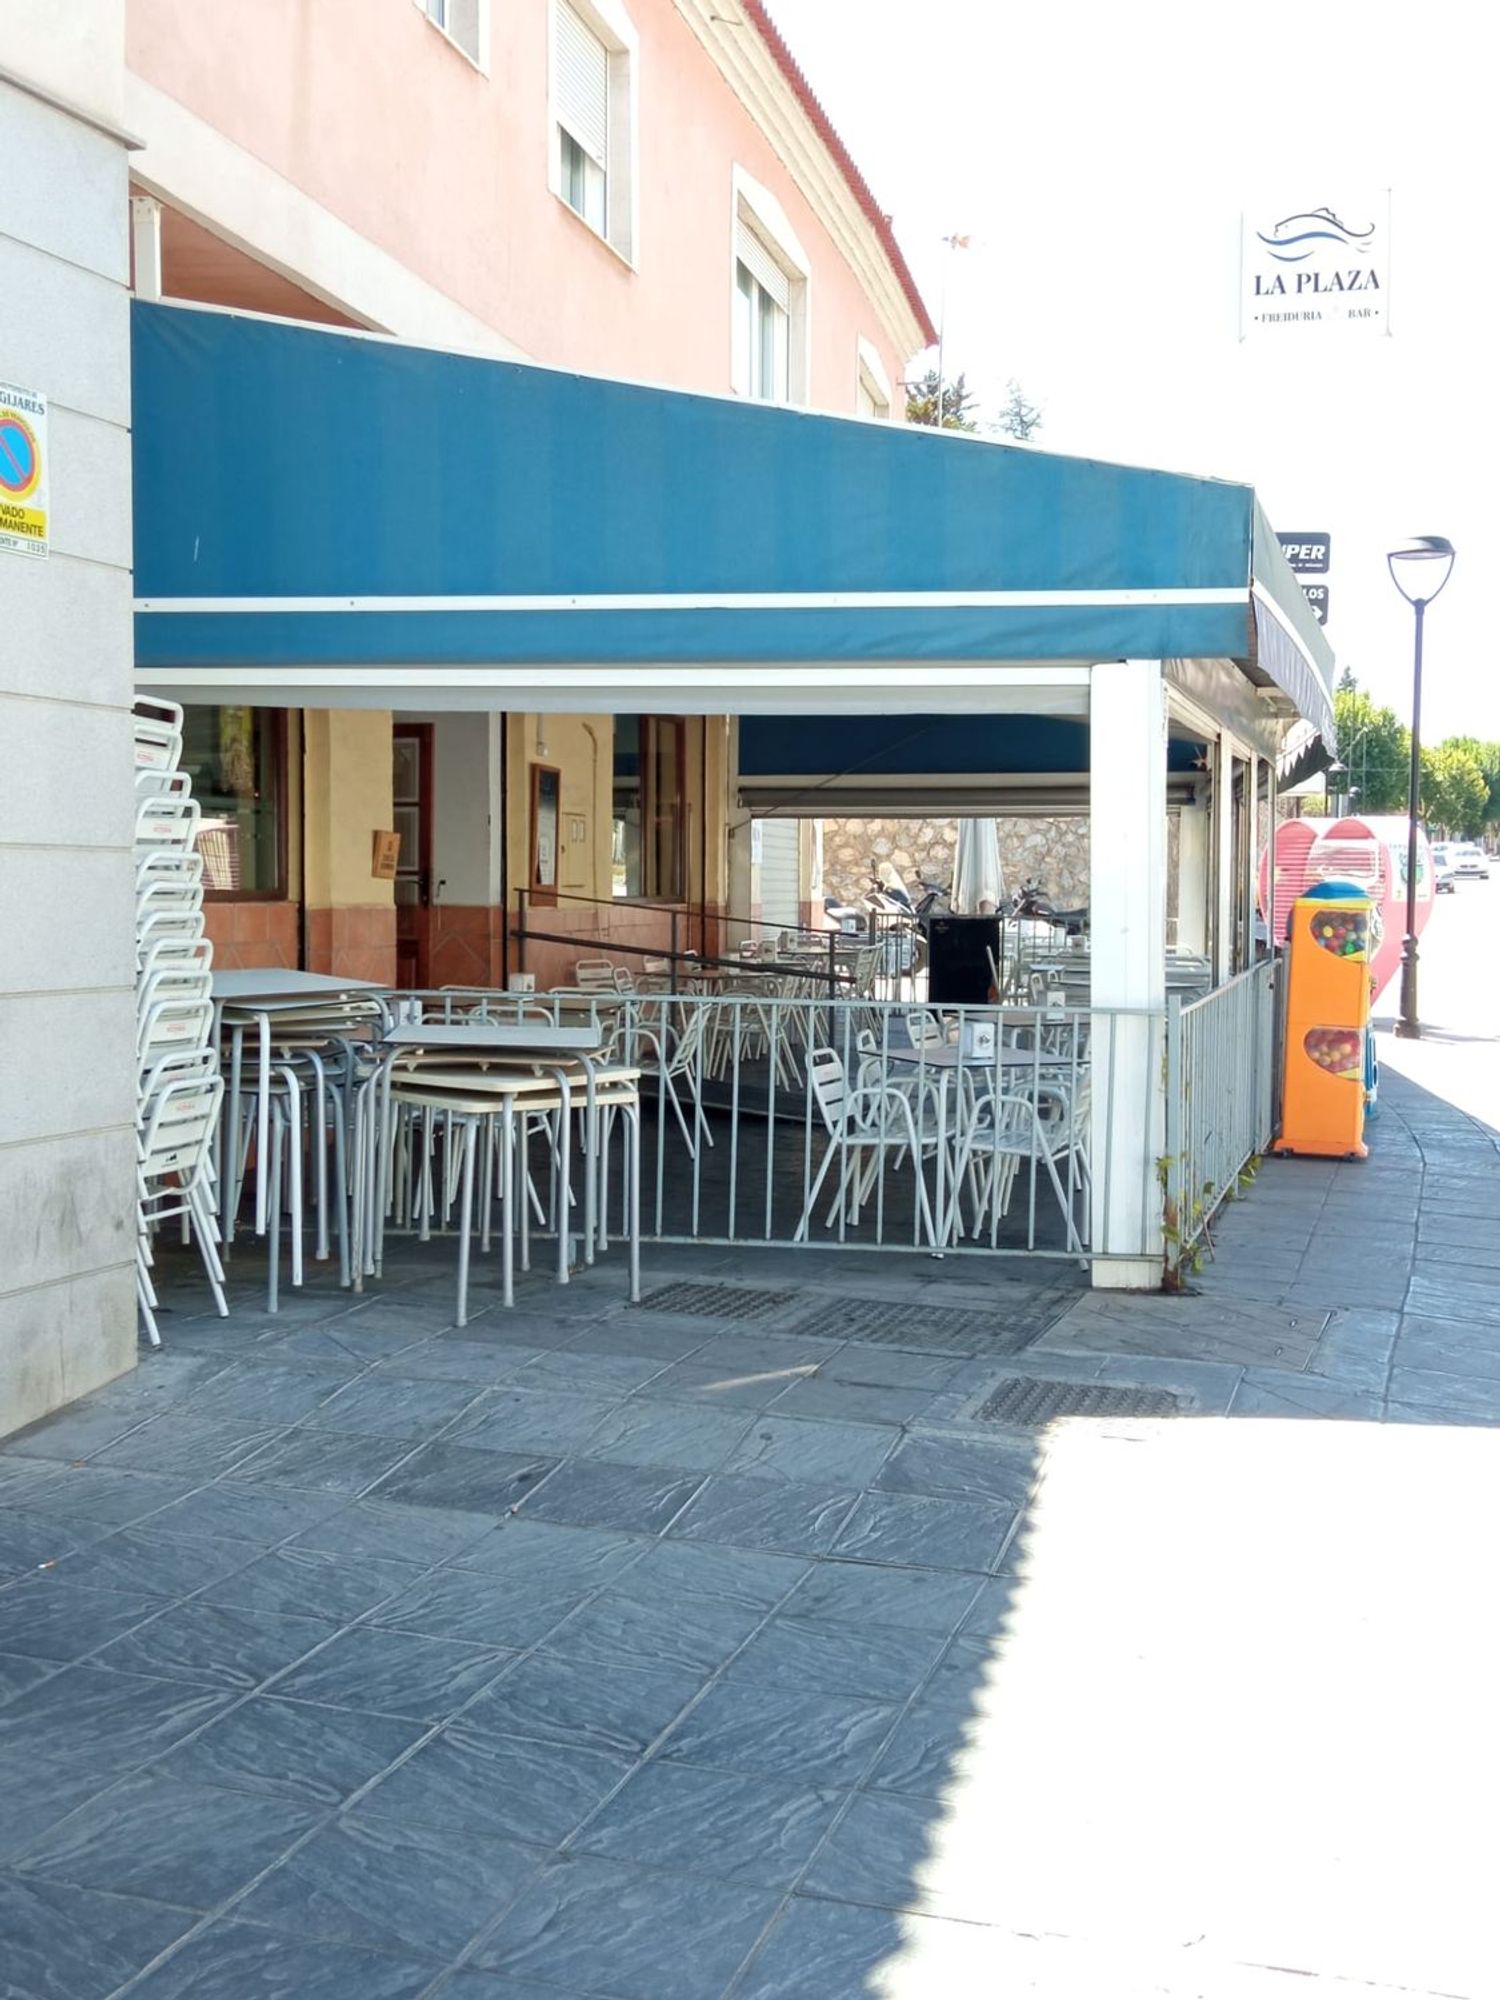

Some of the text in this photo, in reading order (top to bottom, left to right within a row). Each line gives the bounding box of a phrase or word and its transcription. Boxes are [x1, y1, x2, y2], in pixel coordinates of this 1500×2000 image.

[1254, 268, 1381, 296] LA PLAZA
[1261, 309, 1371, 323] FREIDURIA BAR
[1, 504, 25, 520] VADO
